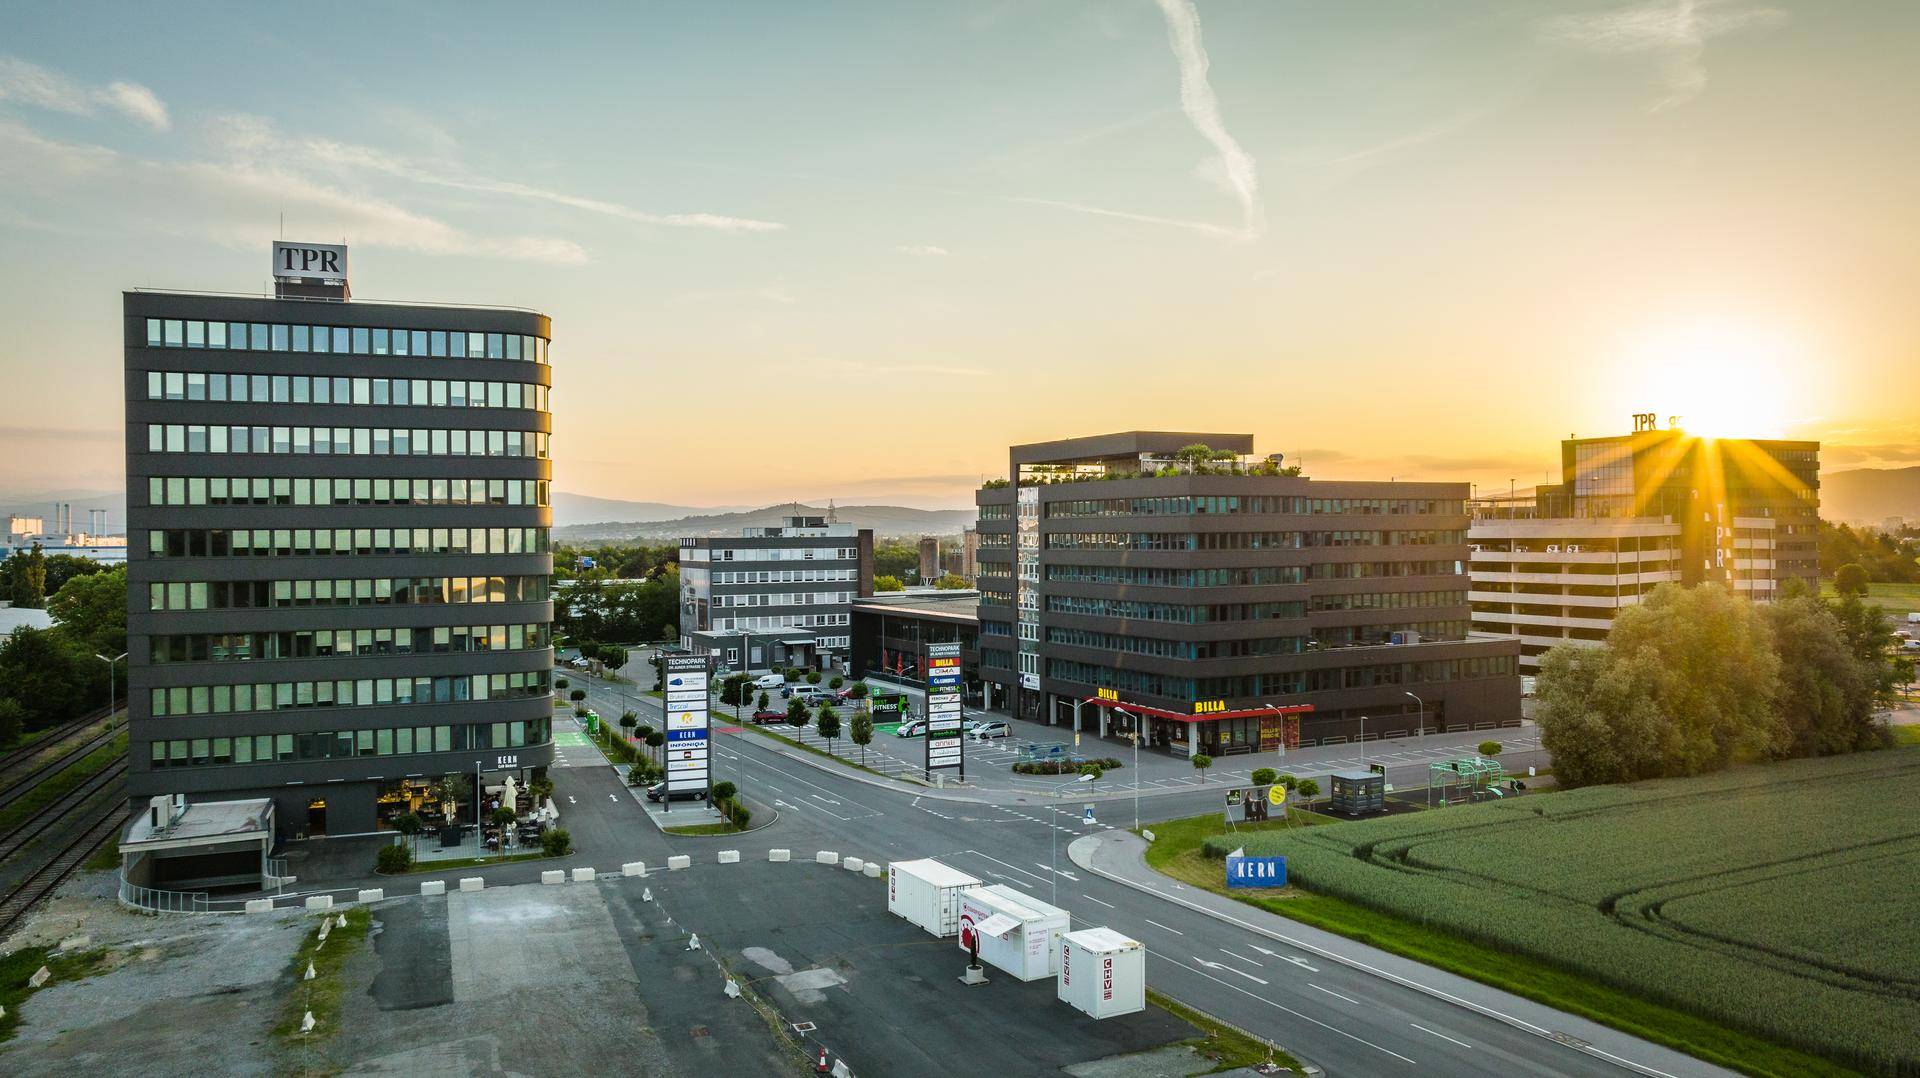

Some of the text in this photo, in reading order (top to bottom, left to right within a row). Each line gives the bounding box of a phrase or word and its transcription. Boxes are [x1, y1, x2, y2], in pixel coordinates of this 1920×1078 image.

[280, 248, 340, 272] TPR
[1632, 413, 1656, 431] TPR
[936, 659, 954, 667] BILLA
[1098, 688, 1118, 700] BILLA
[1195, 700, 1225, 712] BILLA
[679, 731, 696, 739] KERN
[498, 755, 518, 764] KERN
[1238, 862, 1275, 878] KERN
[1104, 959, 1112, 990] CHV
